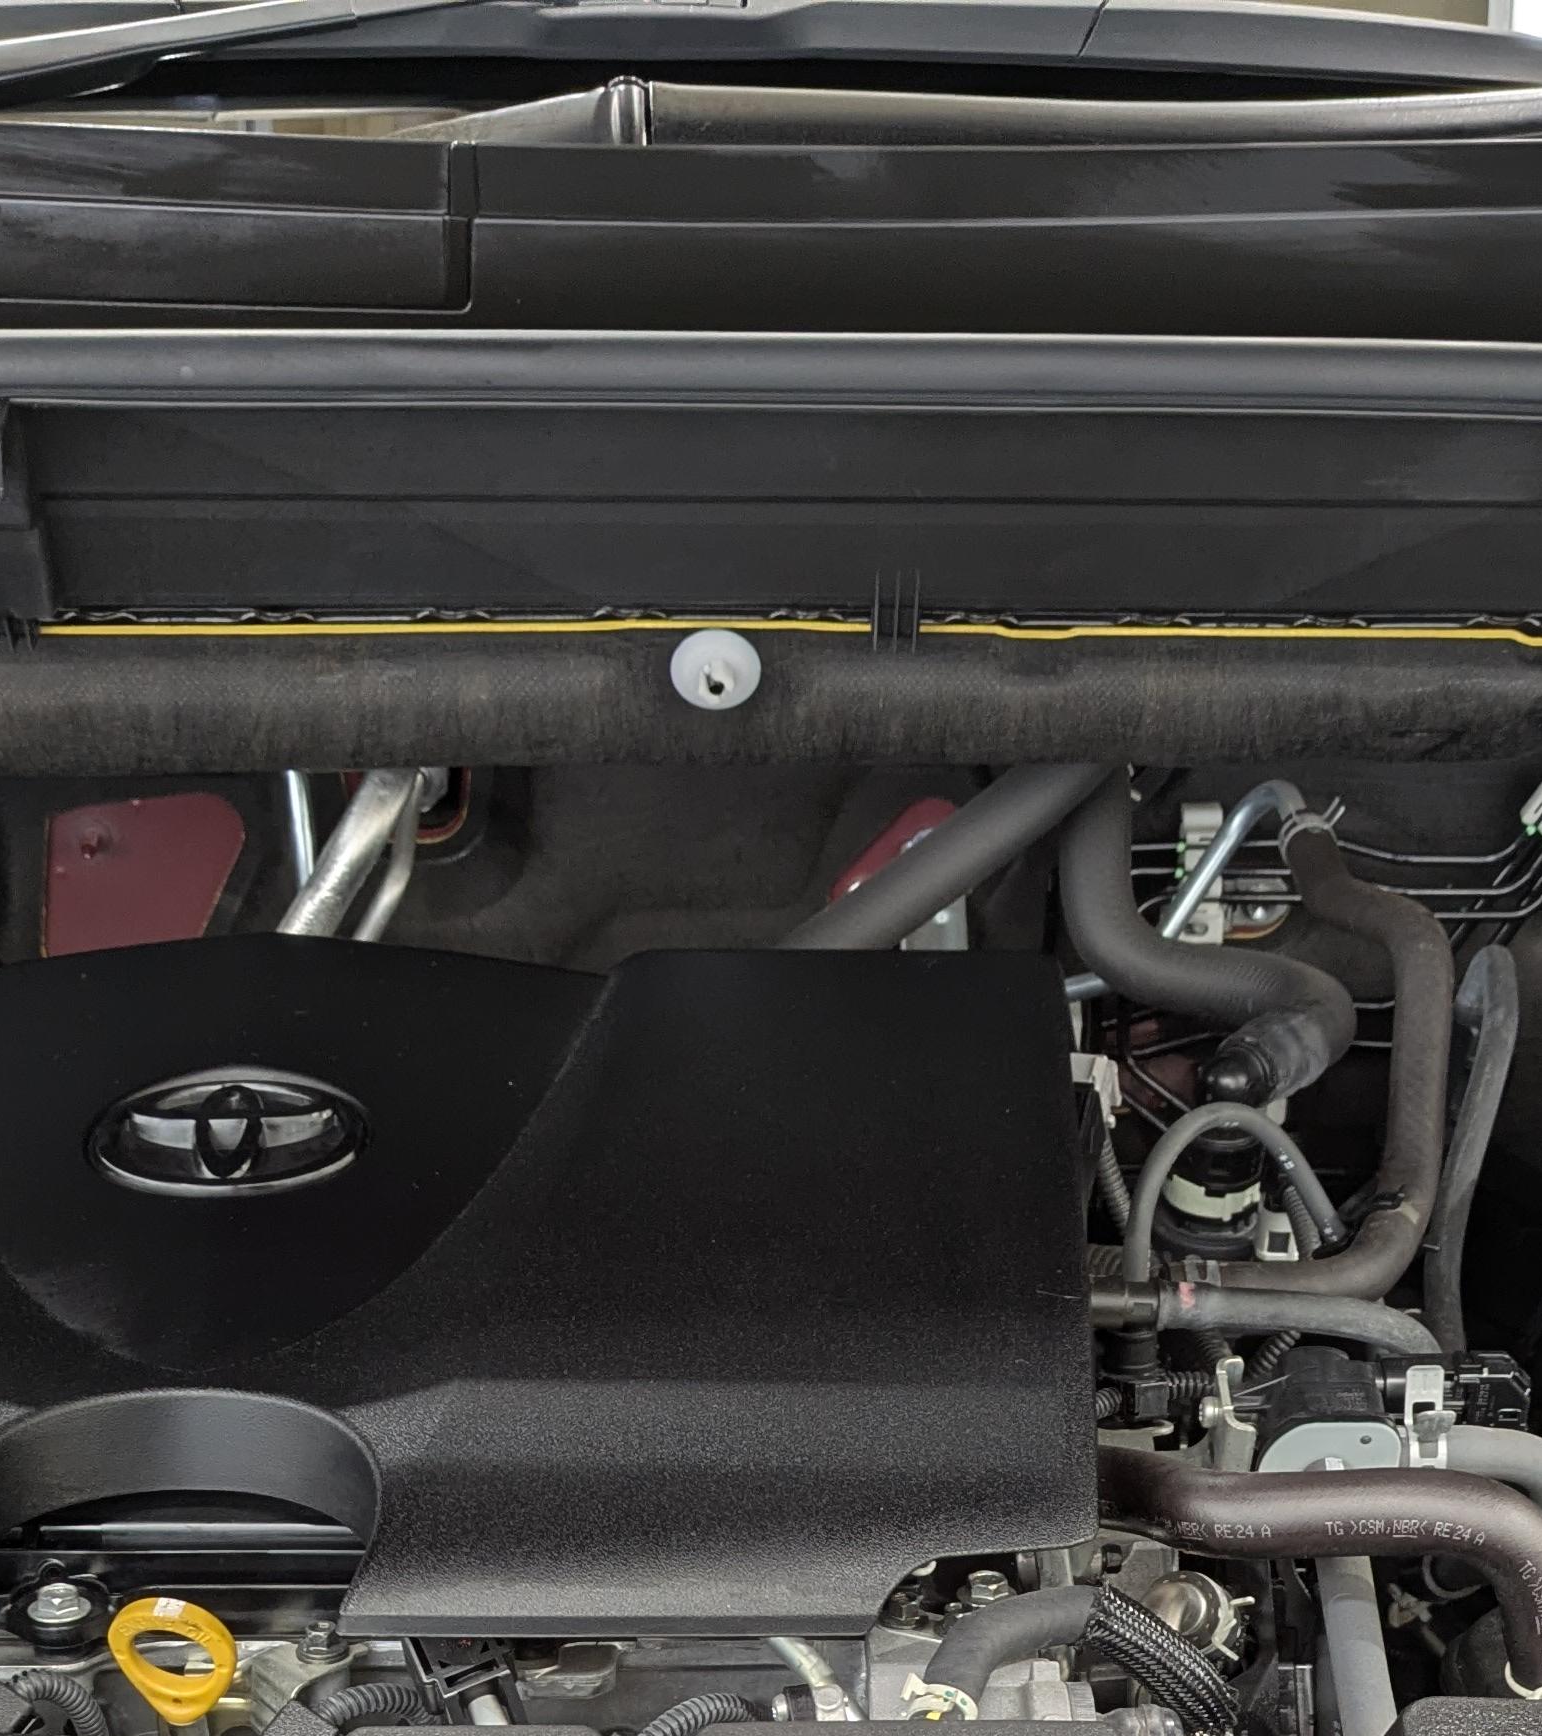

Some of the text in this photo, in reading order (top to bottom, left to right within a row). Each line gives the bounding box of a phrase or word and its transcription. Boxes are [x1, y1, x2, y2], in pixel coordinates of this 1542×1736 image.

[1261, 1525, 1271, 1539] A
[1325, 1522, 1344, 1536] TG
[1518, 1559, 1537, 1580] TG
